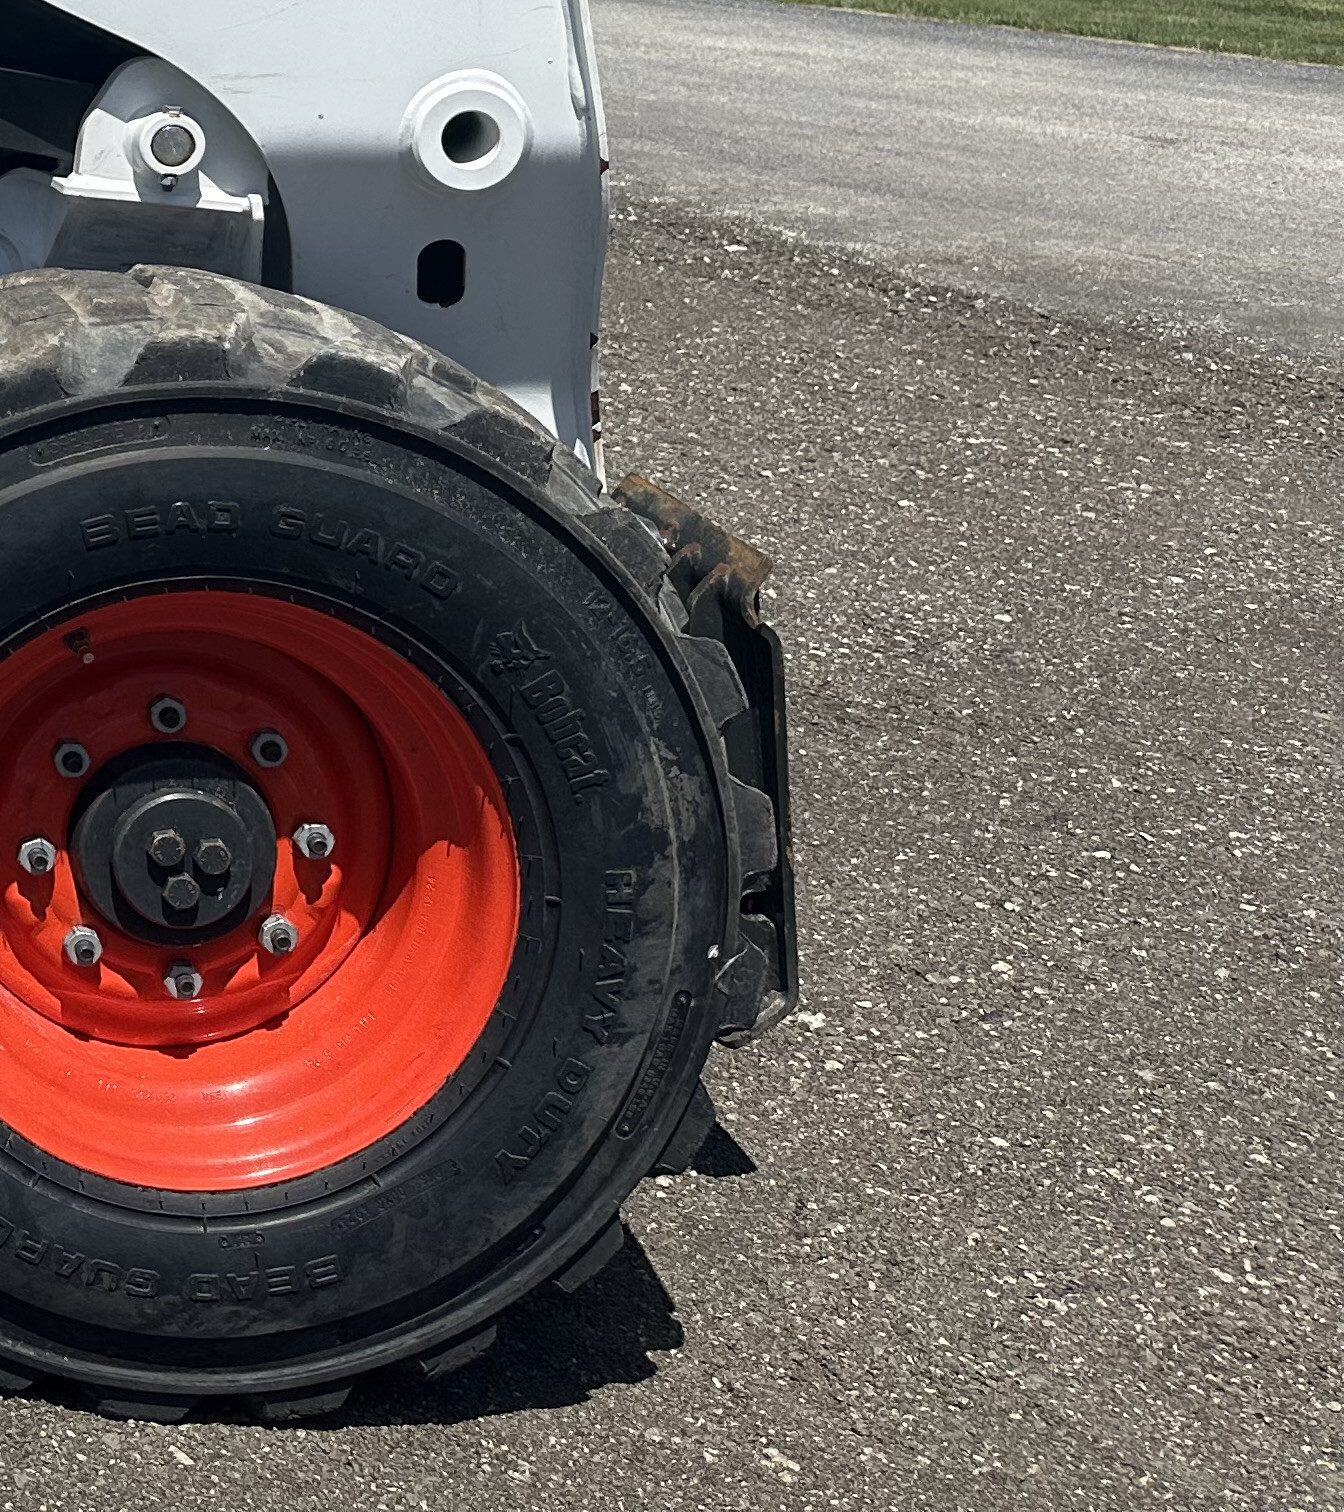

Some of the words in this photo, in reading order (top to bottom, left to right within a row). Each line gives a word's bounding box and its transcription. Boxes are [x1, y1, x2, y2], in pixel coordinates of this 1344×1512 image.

[79, 499, 242, 553] BEAD
[267, 503, 464, 601] GUARD
[519, 669, 609, 805] Bobcat
[582, 869, 637, 1047] HEAVY
[493, 1057, 593, 1186] DUTY
[184, 1254, 343, 1302] BEAD
